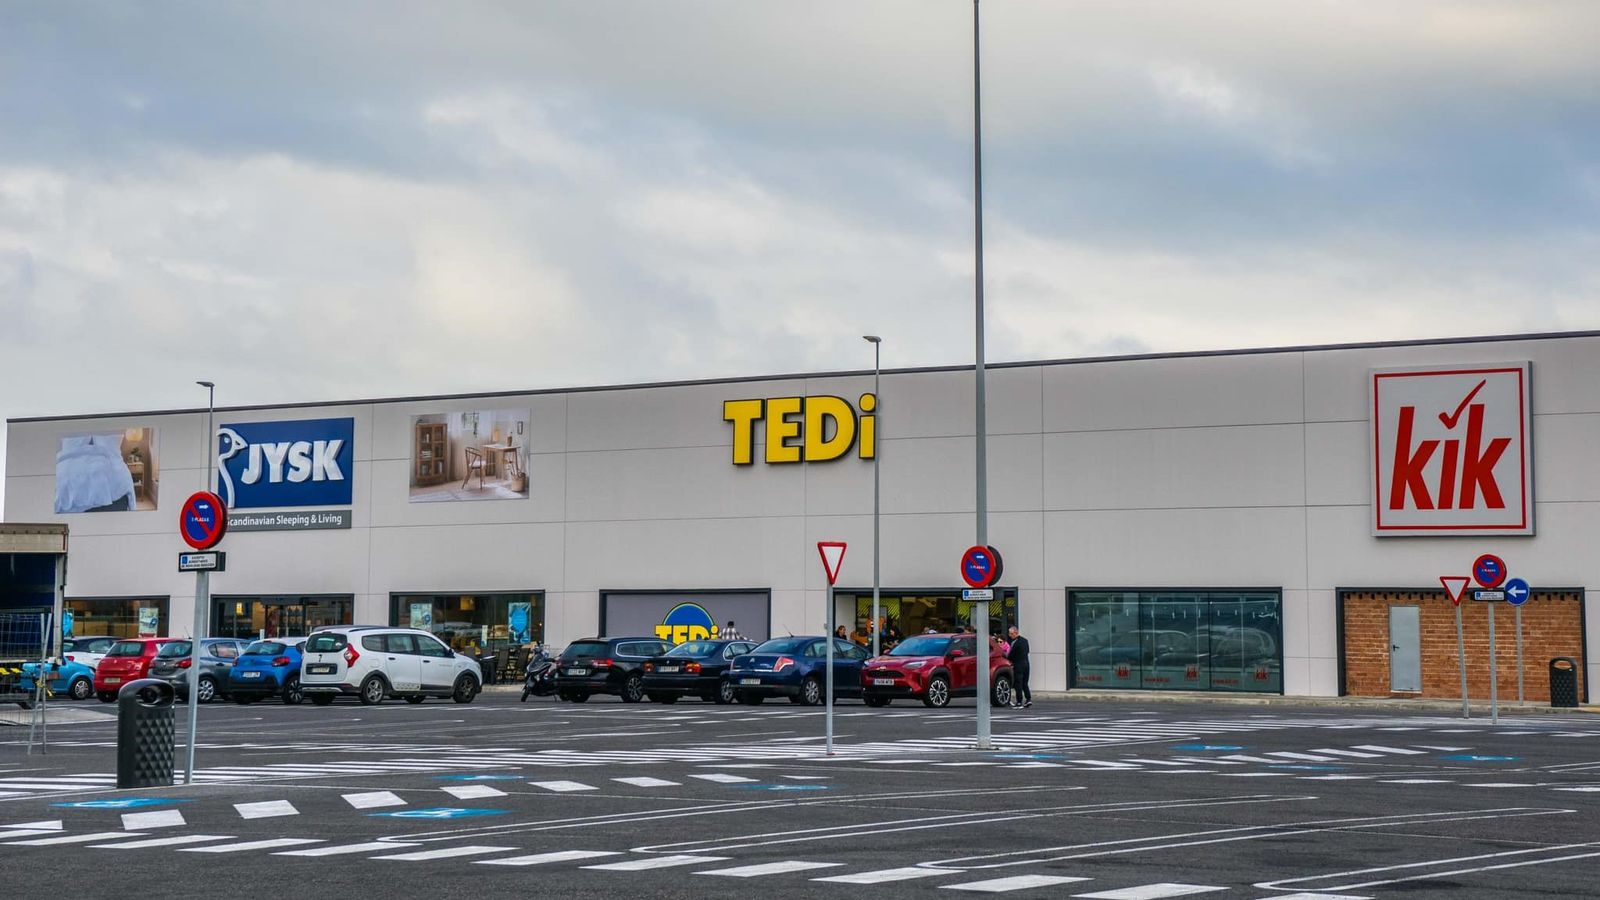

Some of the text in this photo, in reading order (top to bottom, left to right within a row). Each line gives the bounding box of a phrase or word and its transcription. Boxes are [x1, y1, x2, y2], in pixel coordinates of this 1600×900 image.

[723, 393, 877, 465] TEDi
[241, 440, 345, 485] JYSK
[276, 515, 309, 526] Sleeping
[311, 514, 317, 524] &
[318, 514, 342, 525] Living
